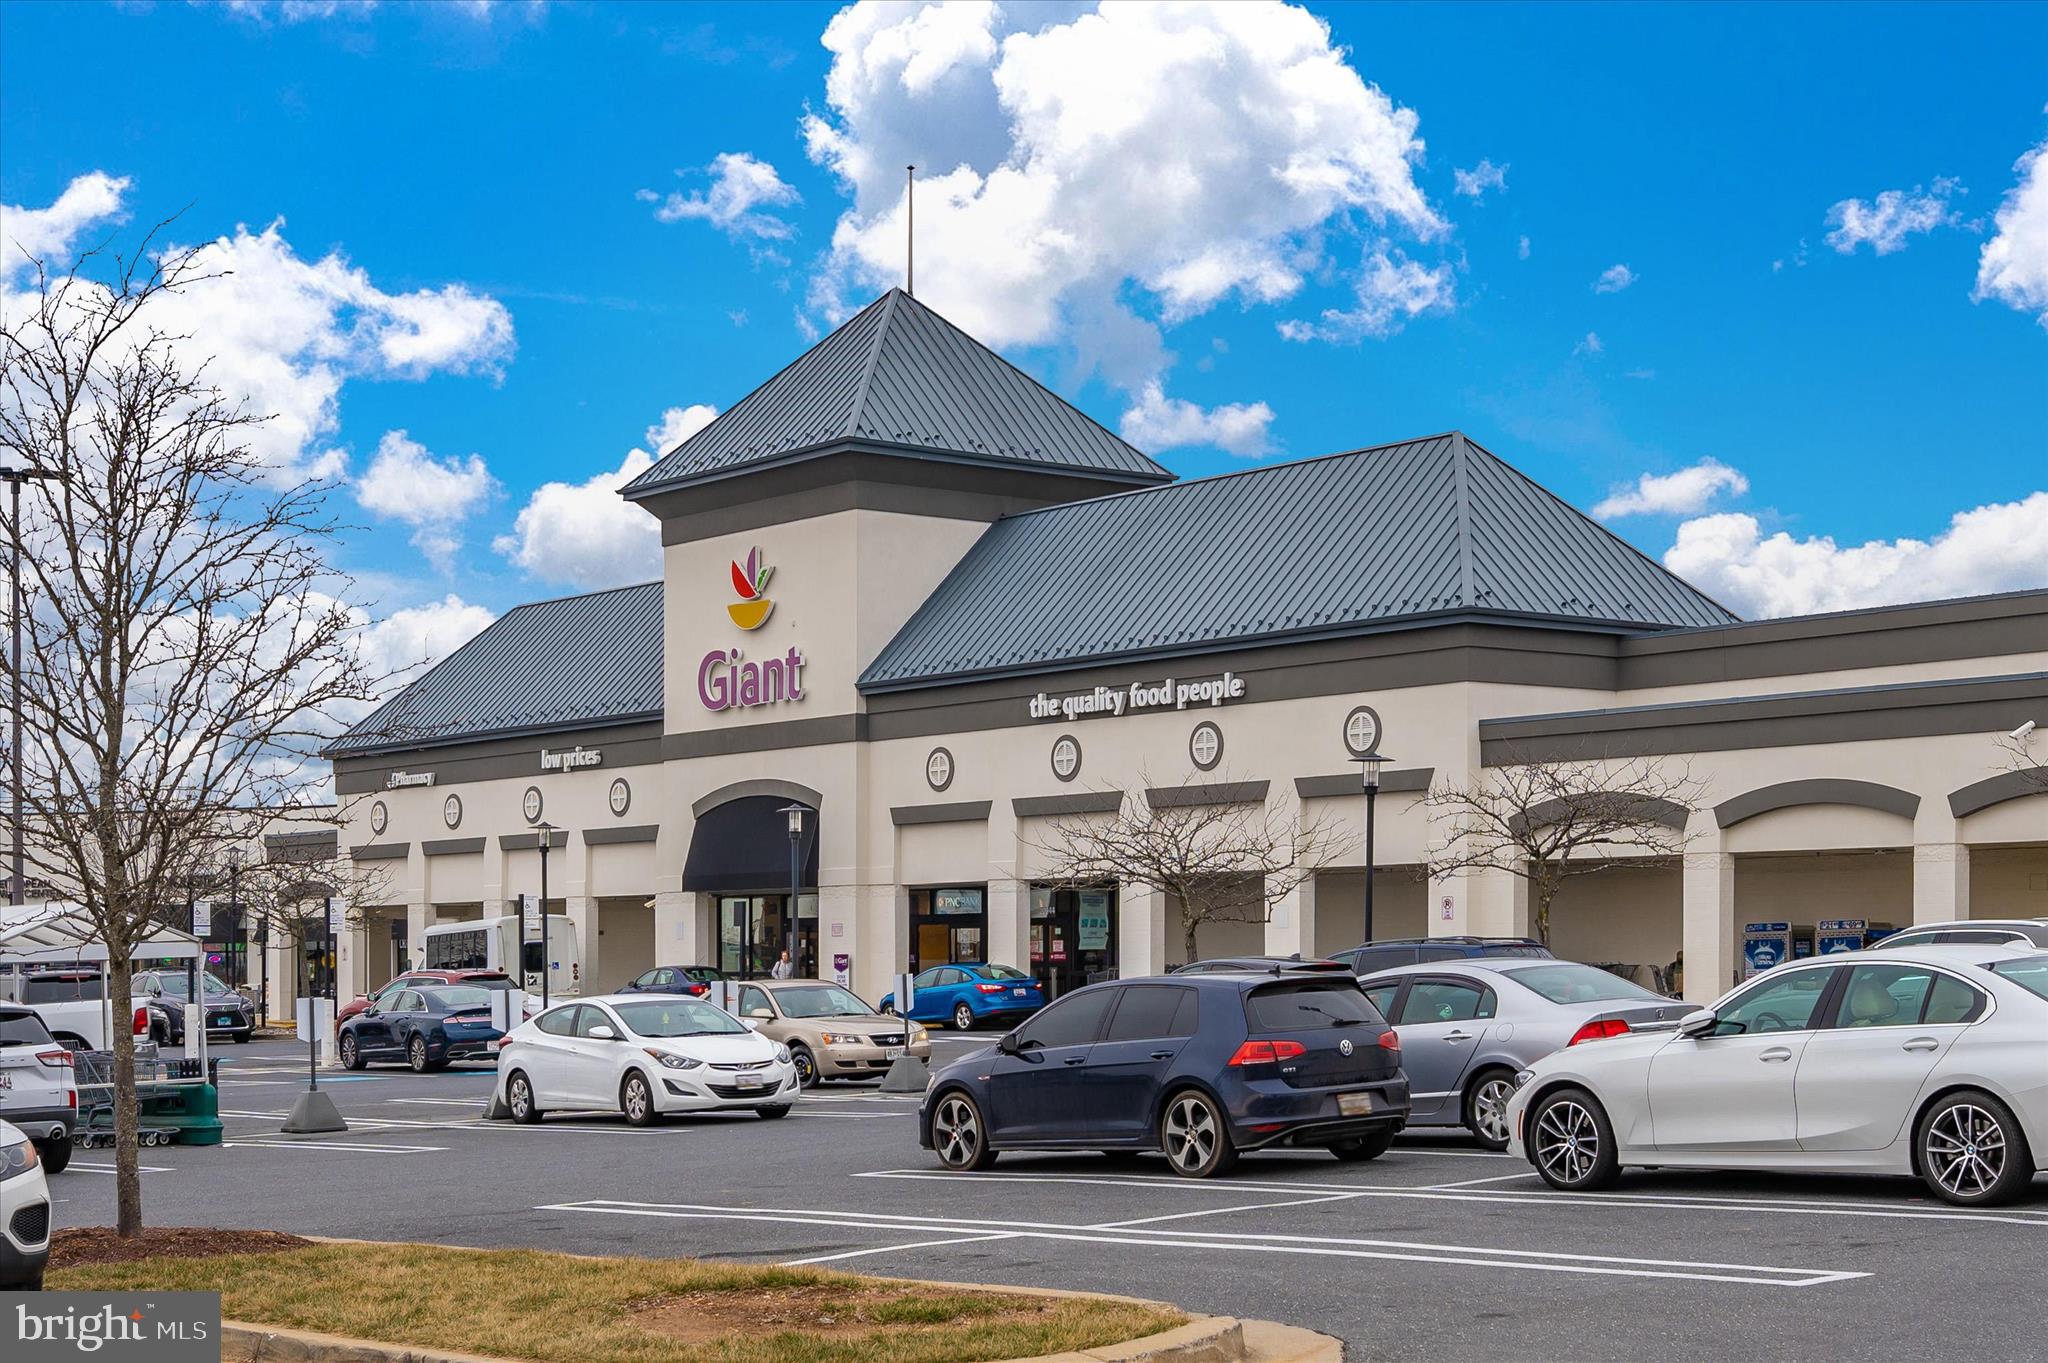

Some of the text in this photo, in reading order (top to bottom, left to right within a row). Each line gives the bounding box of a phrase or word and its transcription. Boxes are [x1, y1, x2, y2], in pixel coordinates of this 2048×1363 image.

[698, 646, 807, 711] Giant
[1029, 672, 1246, 720] the quality food people
[541, 746, 602, 772] low prices
[395, 771, 436, 787] Pharmacy
